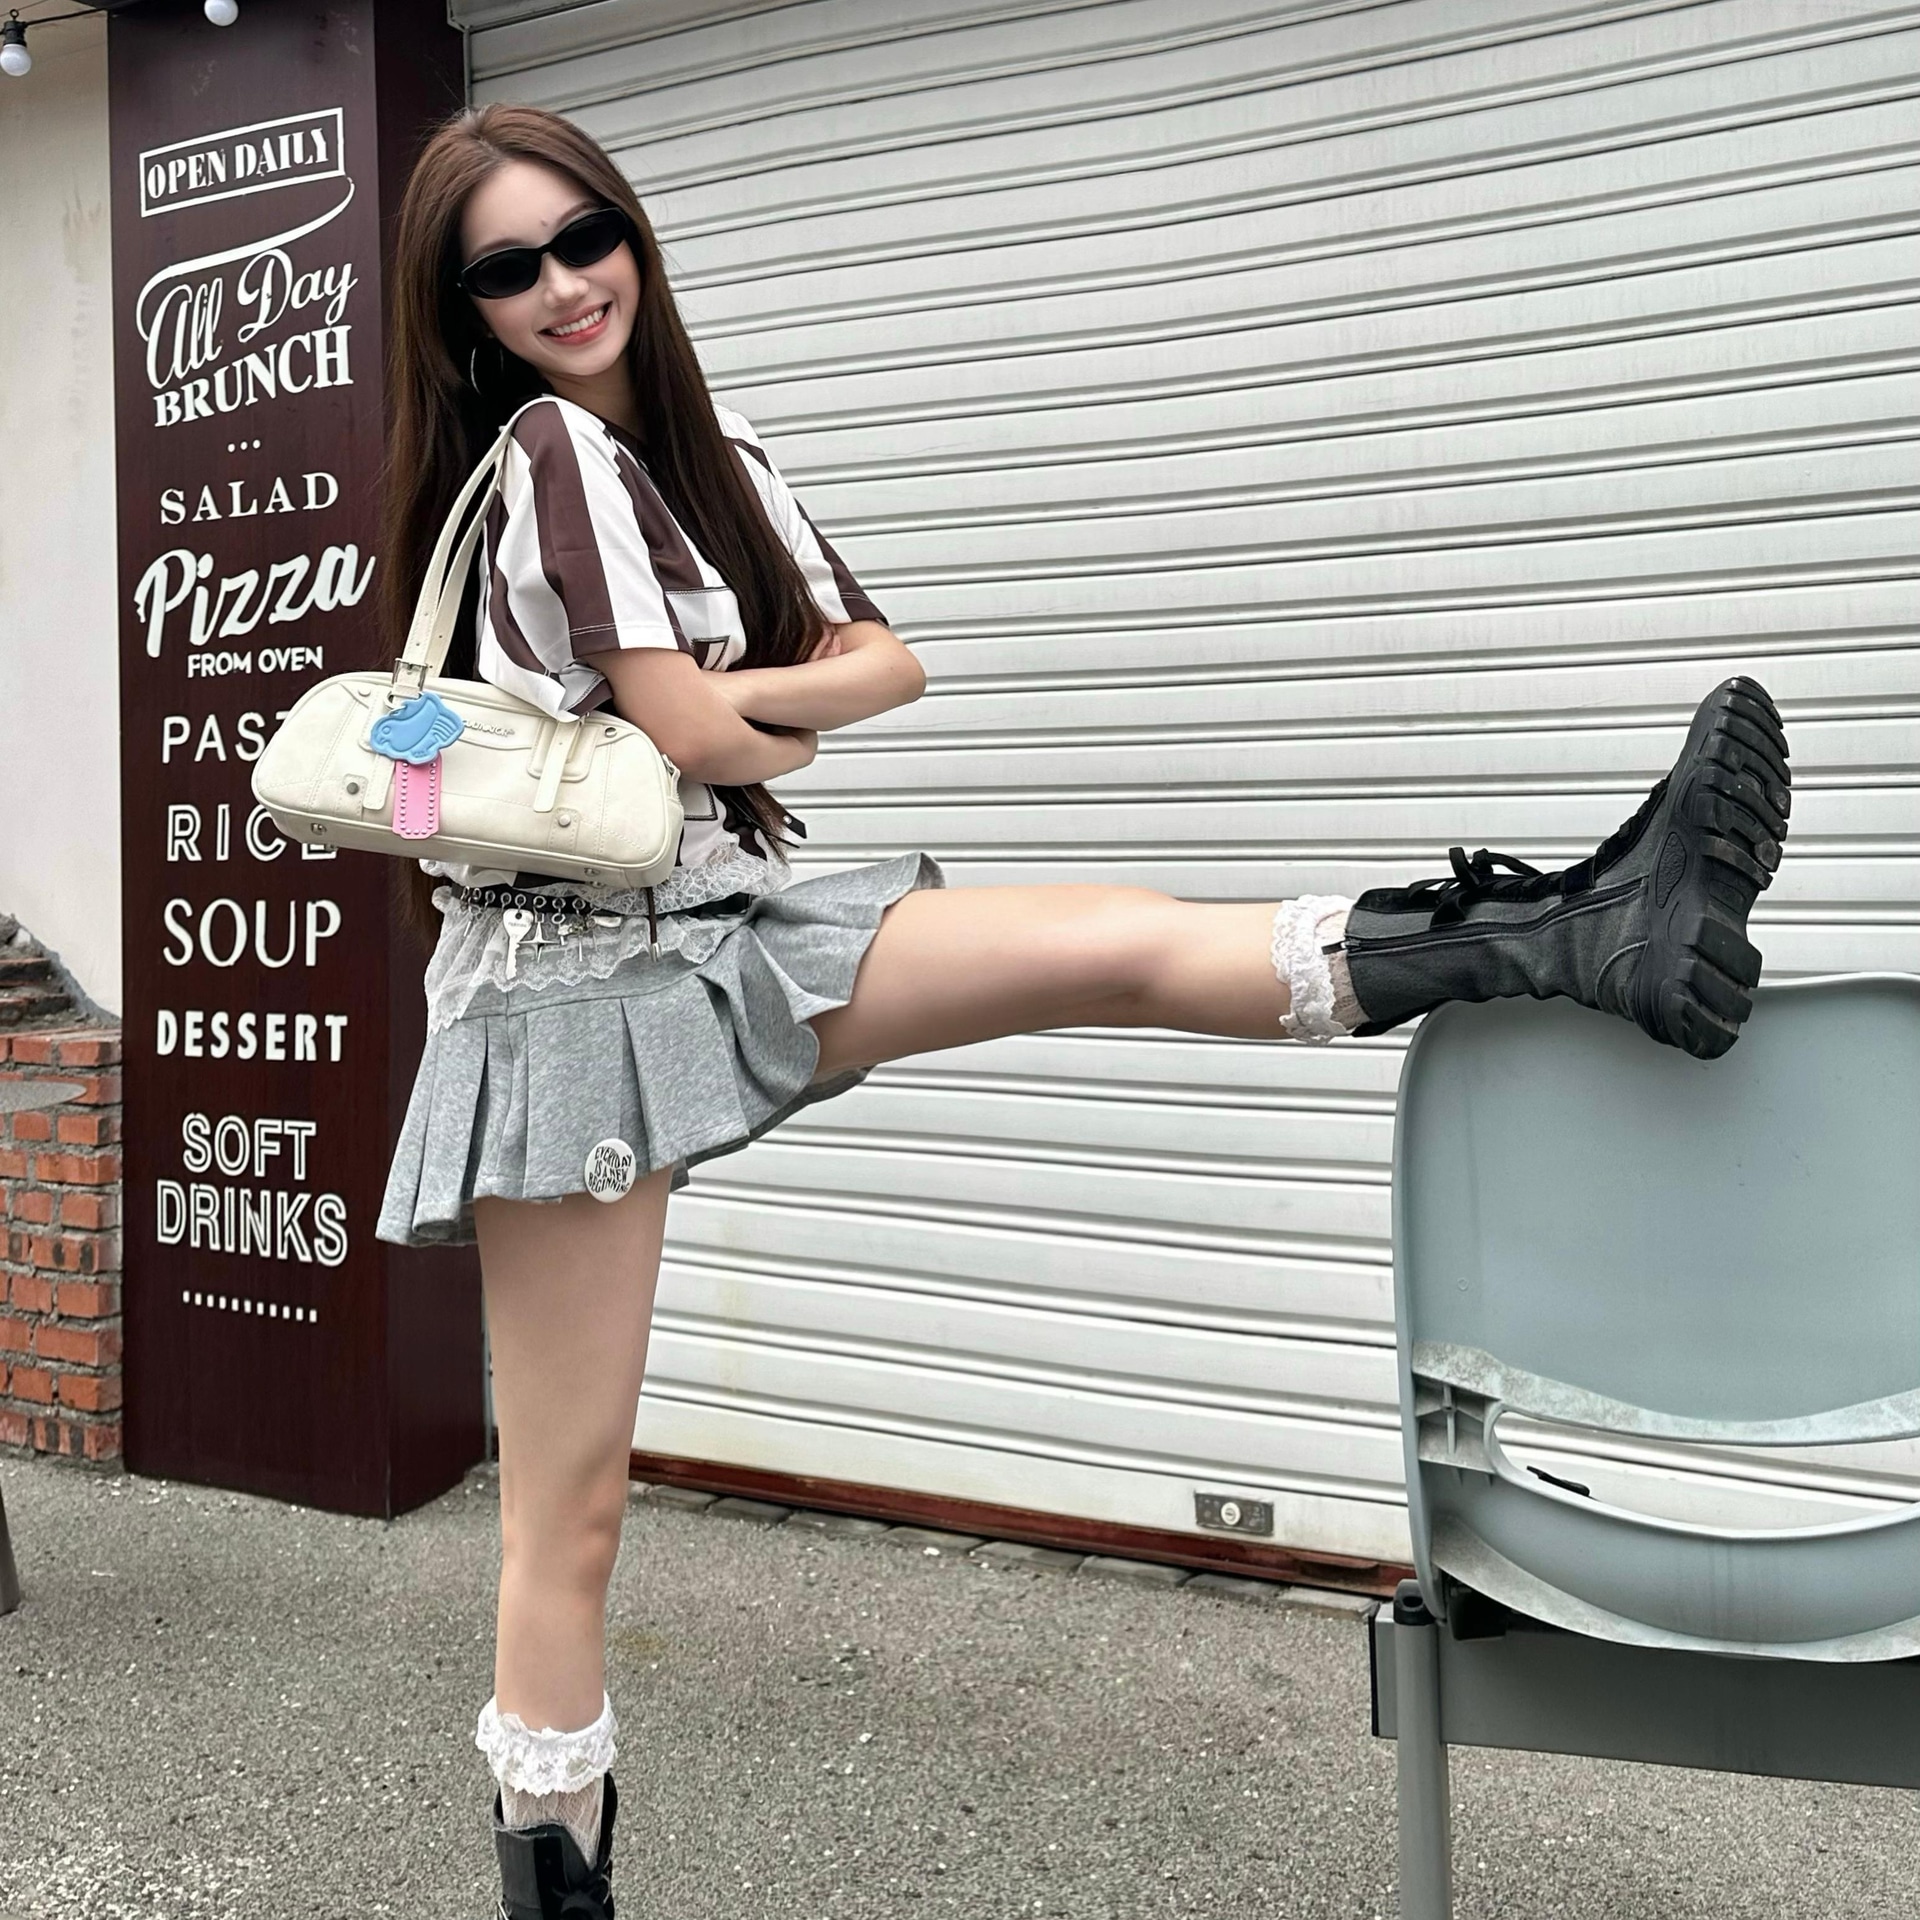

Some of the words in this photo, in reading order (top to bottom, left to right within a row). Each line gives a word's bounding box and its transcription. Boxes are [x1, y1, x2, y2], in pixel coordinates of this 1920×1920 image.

[147, 147, 227, 199] OPEN
[234, 127, 329, 179] DAILY
[146, 276, 224, 390] All
[236, 248, 358, 344] Day
[152, 324, 354, 427] BRUNCH
[160, 471, 339, 525] SALAD
[134, 543, 376, 659] Pizza
[187, 652, 252, 679] FROM
[257, 645, 324, 673] OVEN
[162, 711, 289, 764] PAS
[162, 898, 342, 968] SOUP
[156, 1009, 348, 1062] DESSERT
[182, 1112, 317, 1180] SOFT
[156, 1179, 348, 1267] DRINKS
